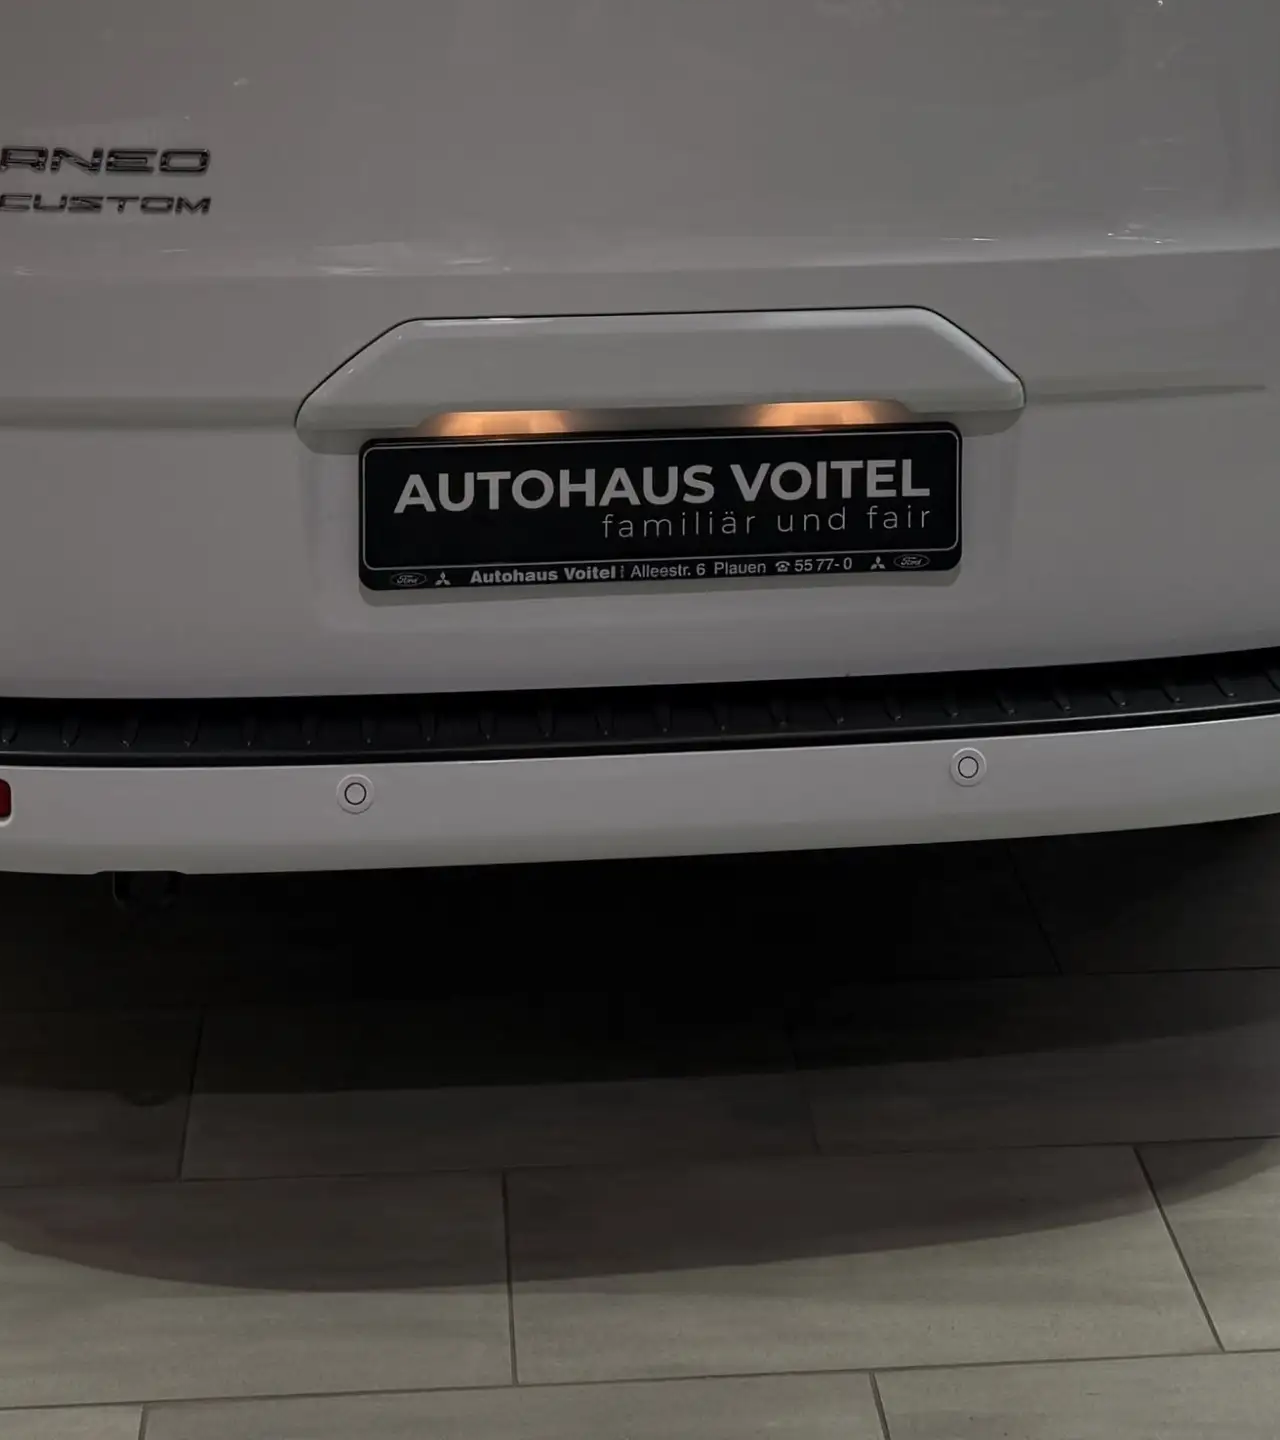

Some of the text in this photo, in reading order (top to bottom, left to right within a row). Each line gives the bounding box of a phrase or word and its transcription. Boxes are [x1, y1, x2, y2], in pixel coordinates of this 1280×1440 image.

[393, 458, 931, 515] AUTOHAUS VOITEL
[601, 502, 931, 539] familiär und fair
[470, 570, 558, 584] Autohaus
[564, 565, 616, 580] Voitel
[631, 564, 691, 578] Alleestr.
[696, 563, 705, 575] 6
[714, 561, 767, 575] Plauen
